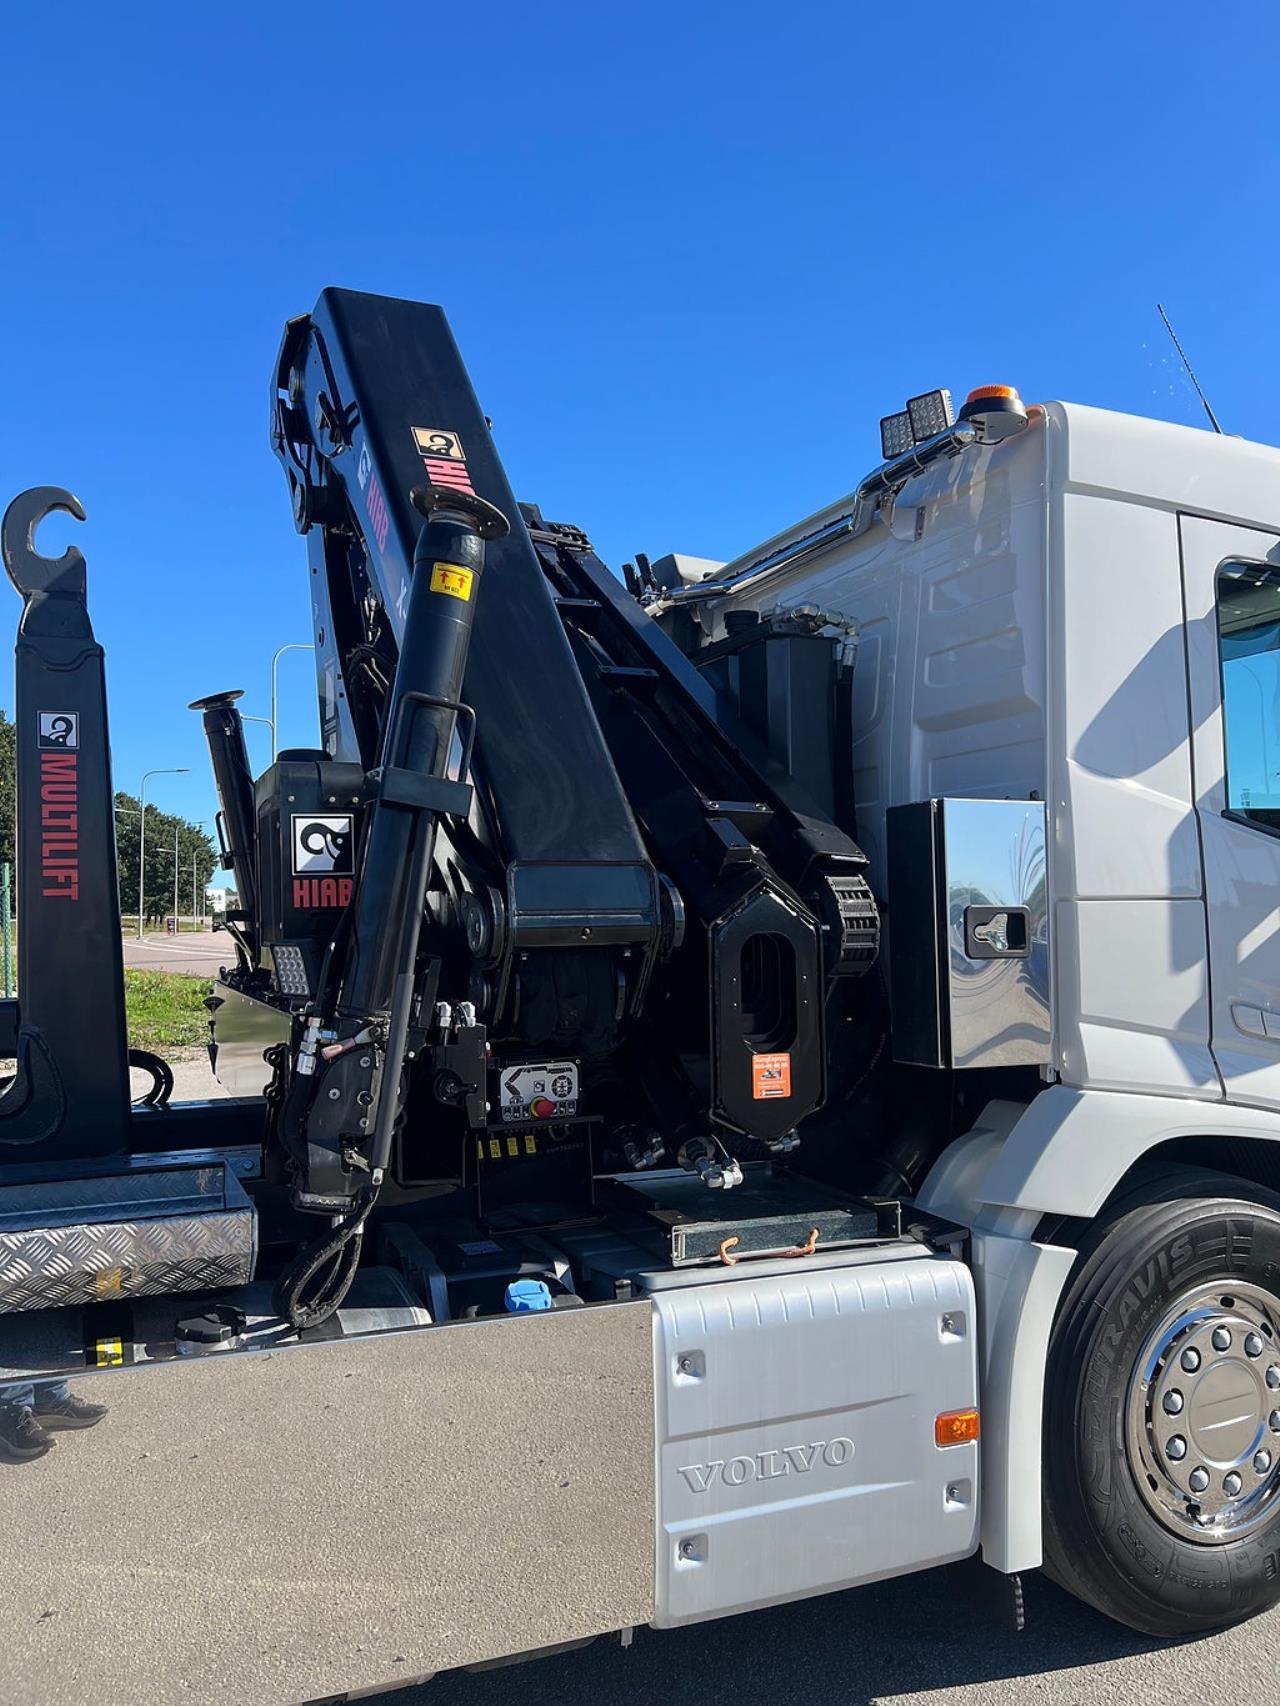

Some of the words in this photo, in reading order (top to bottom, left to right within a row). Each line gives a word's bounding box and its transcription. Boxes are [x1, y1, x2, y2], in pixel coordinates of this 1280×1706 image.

[365, 471, 390, 555] HIAB
[41, 753, 79, 901] MULTILIFT
[293, 879, 353, 908] HIAB
[677, 1436, 856, 1493] VOLVO
